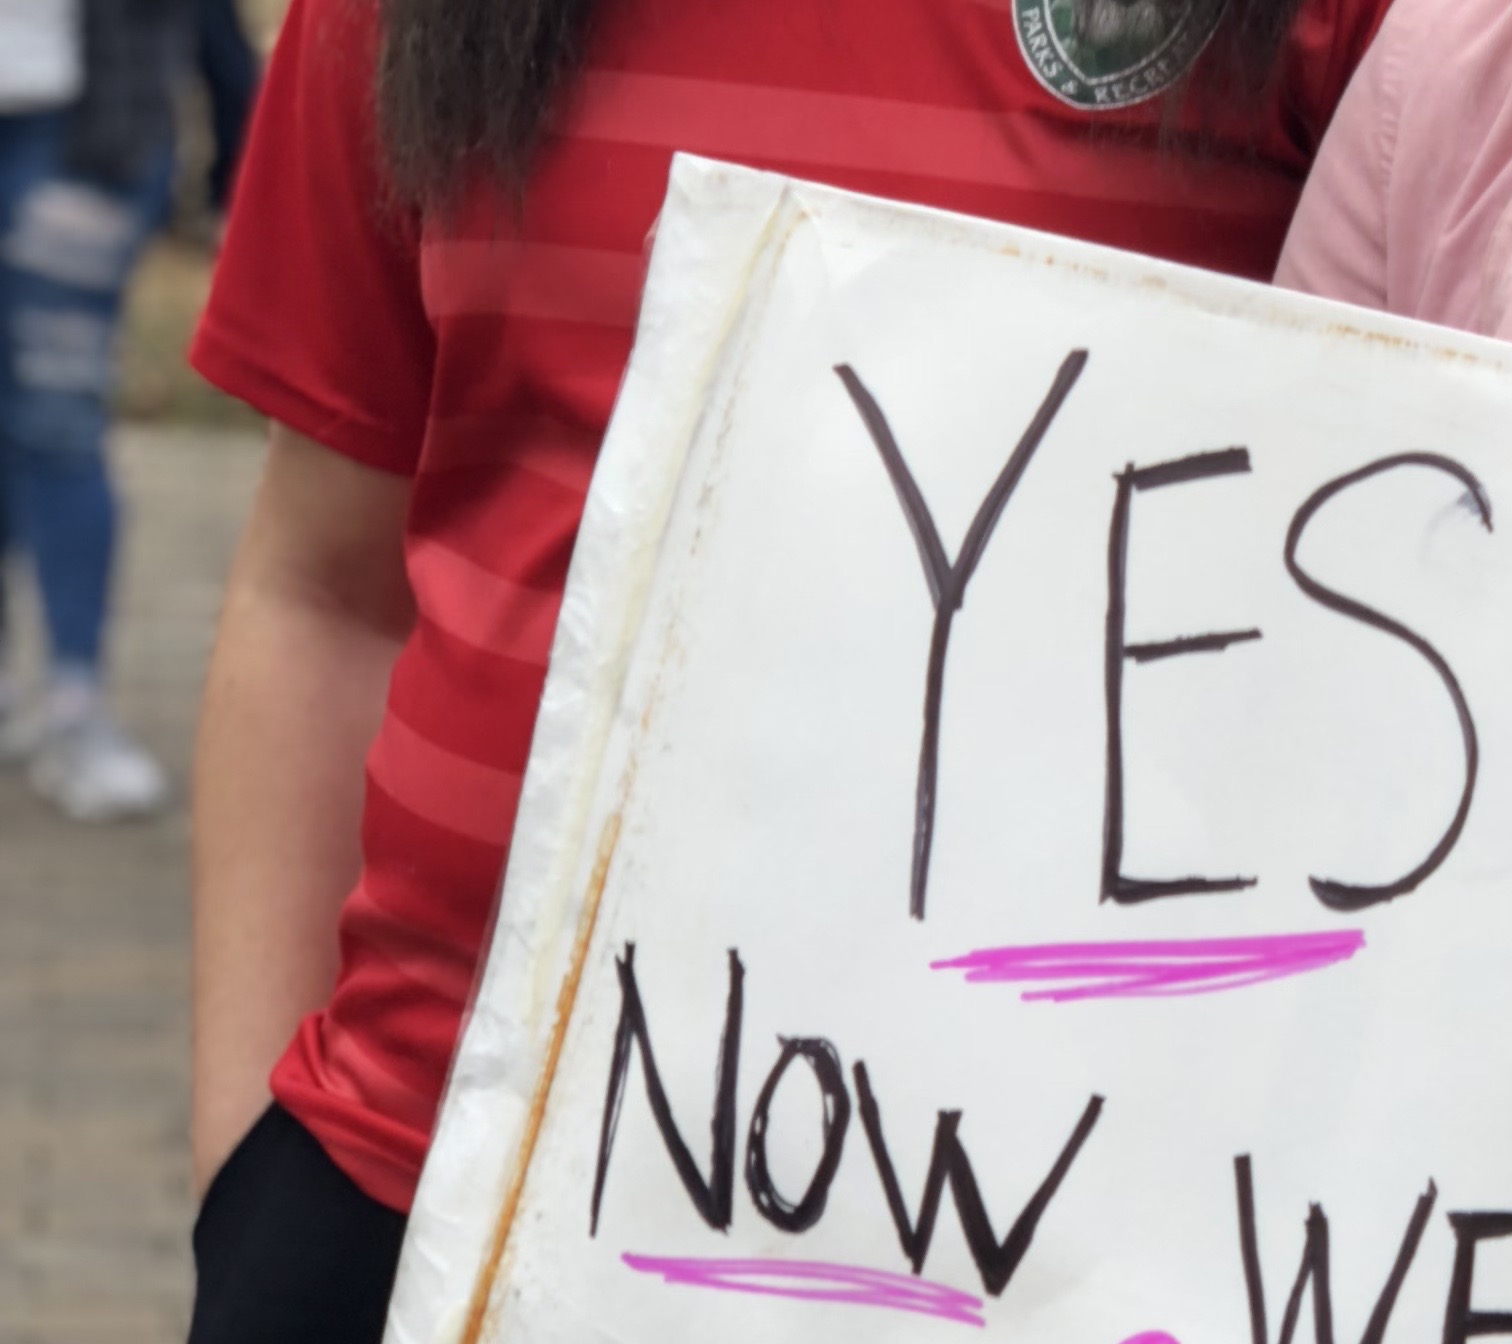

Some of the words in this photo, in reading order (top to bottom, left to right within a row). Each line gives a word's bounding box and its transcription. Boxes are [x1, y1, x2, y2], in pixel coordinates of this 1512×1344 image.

[1021, 6, 1063, 78] PARKS
[834, 348, 1492, 921] YES
[589, 940, 1105, 1297] NOW
